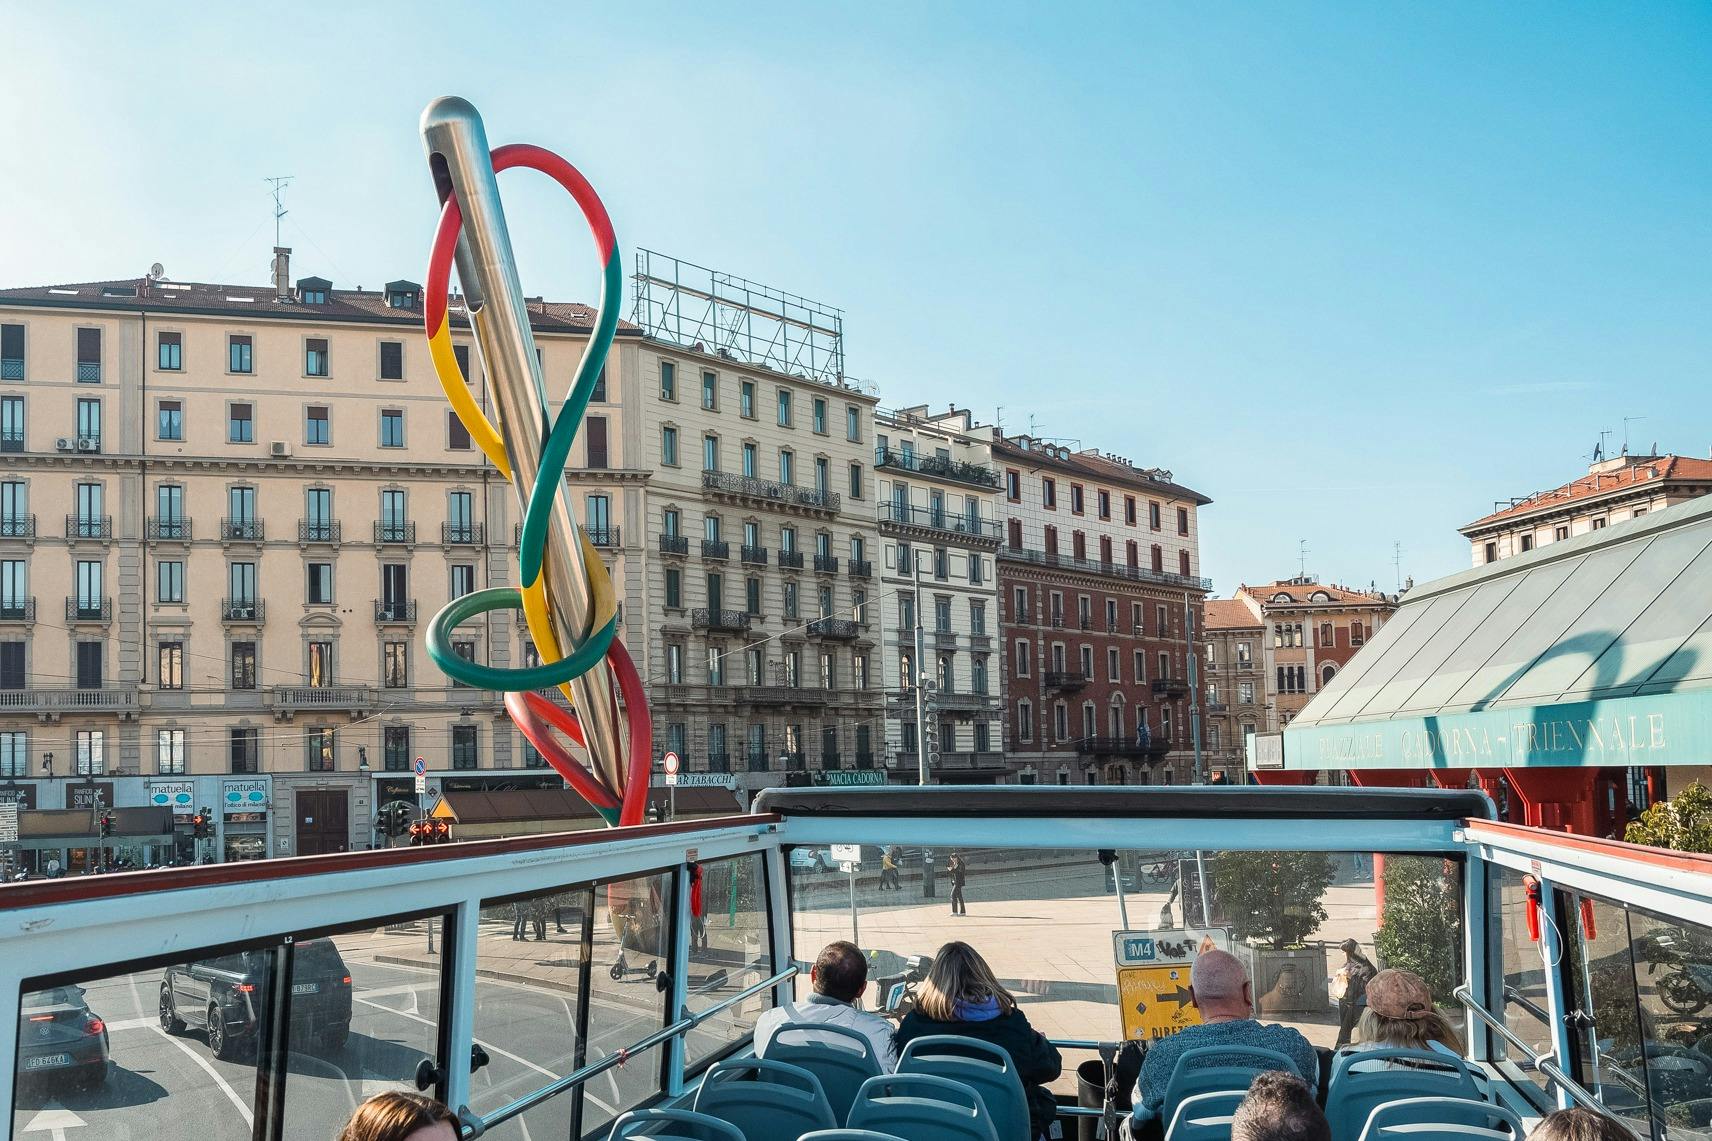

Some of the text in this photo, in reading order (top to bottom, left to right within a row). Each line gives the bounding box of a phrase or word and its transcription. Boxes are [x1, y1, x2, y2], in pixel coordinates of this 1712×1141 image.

[1401, 728, 1492, 757] CADORNA
[1513, 712, 1666, 753] TRIENNALE
[676, 775, 689, 785] AR
[691, 775, 732, 785] TABACCHI
[852, 772, 883, 785] CADORNA
[151, 783, 192, 794] matuella
[224, 781, 265, 792] matuella
[284, 936, 293, 944] L2
[1131, 943, 1152, 957] M4
